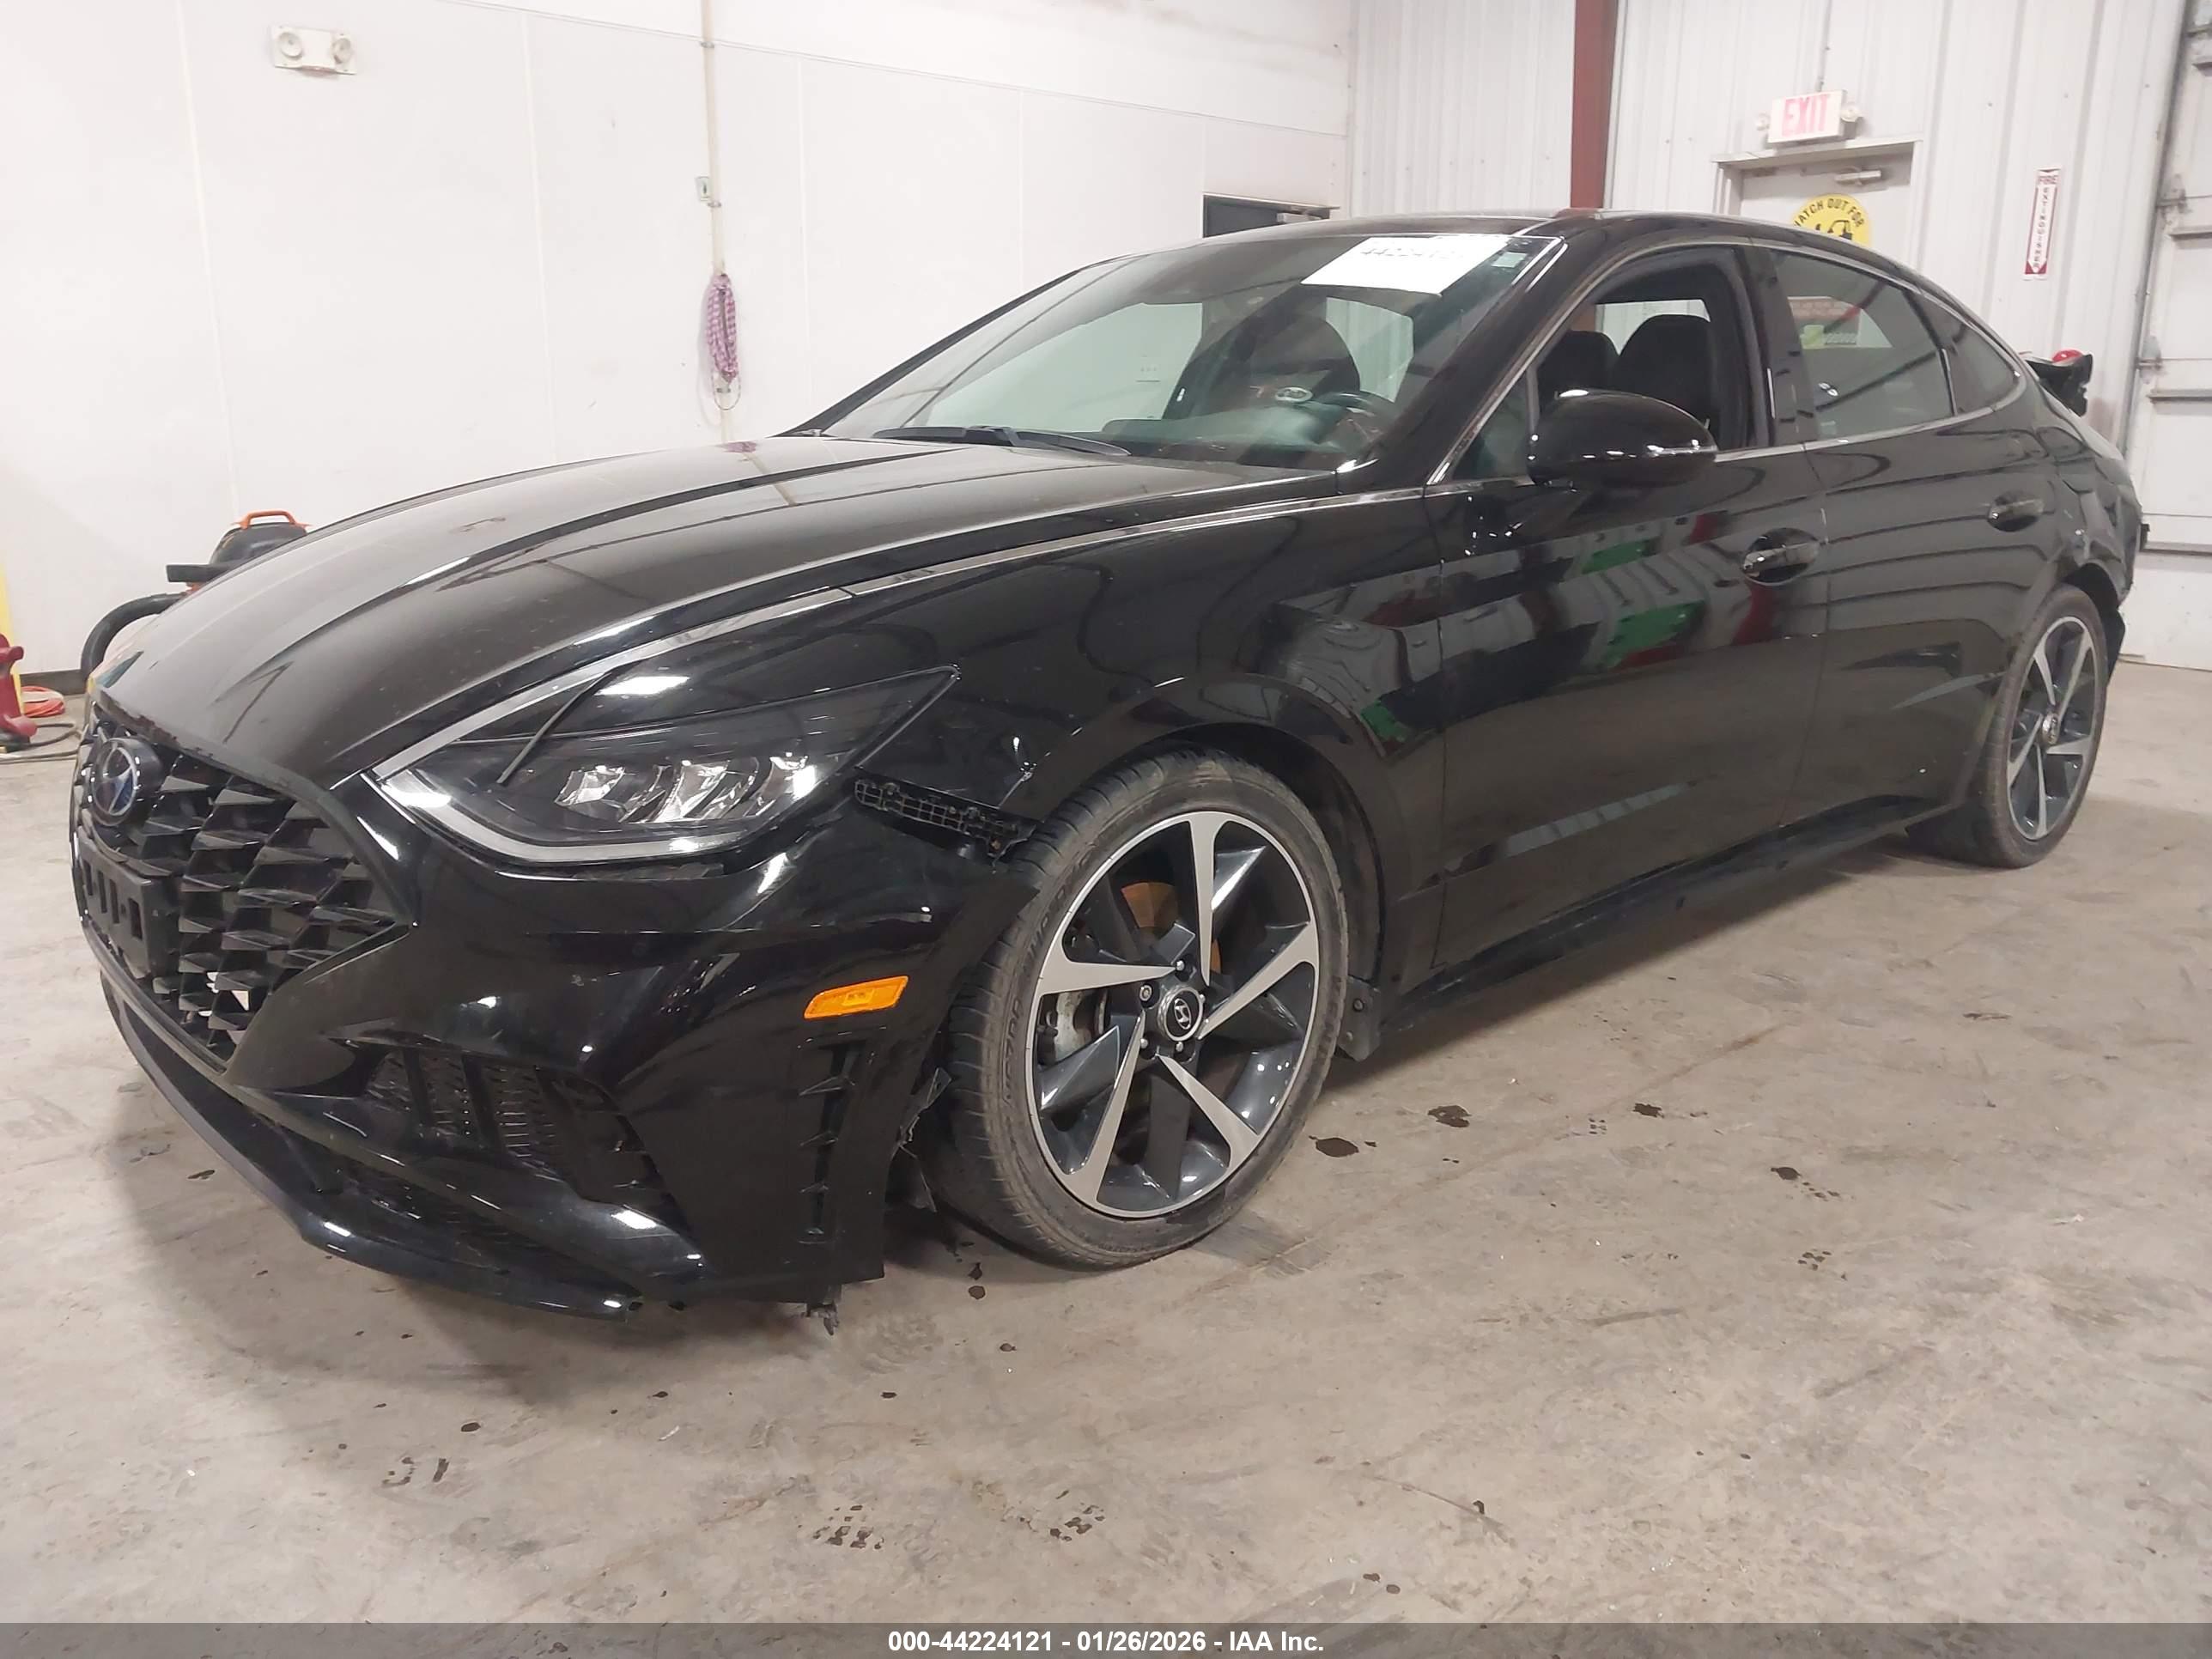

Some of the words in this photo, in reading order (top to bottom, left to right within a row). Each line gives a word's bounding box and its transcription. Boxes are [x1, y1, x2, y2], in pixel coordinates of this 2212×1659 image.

[1782, 93, 1830, 137] EXIT
[2038, 174, 2059, 185] FIRE
[1827, 198, 1850, 210] OUT
[1848, 206, 1864, 227] FOR
[2033, 186, 2049, 268] EXTINGUISHER
